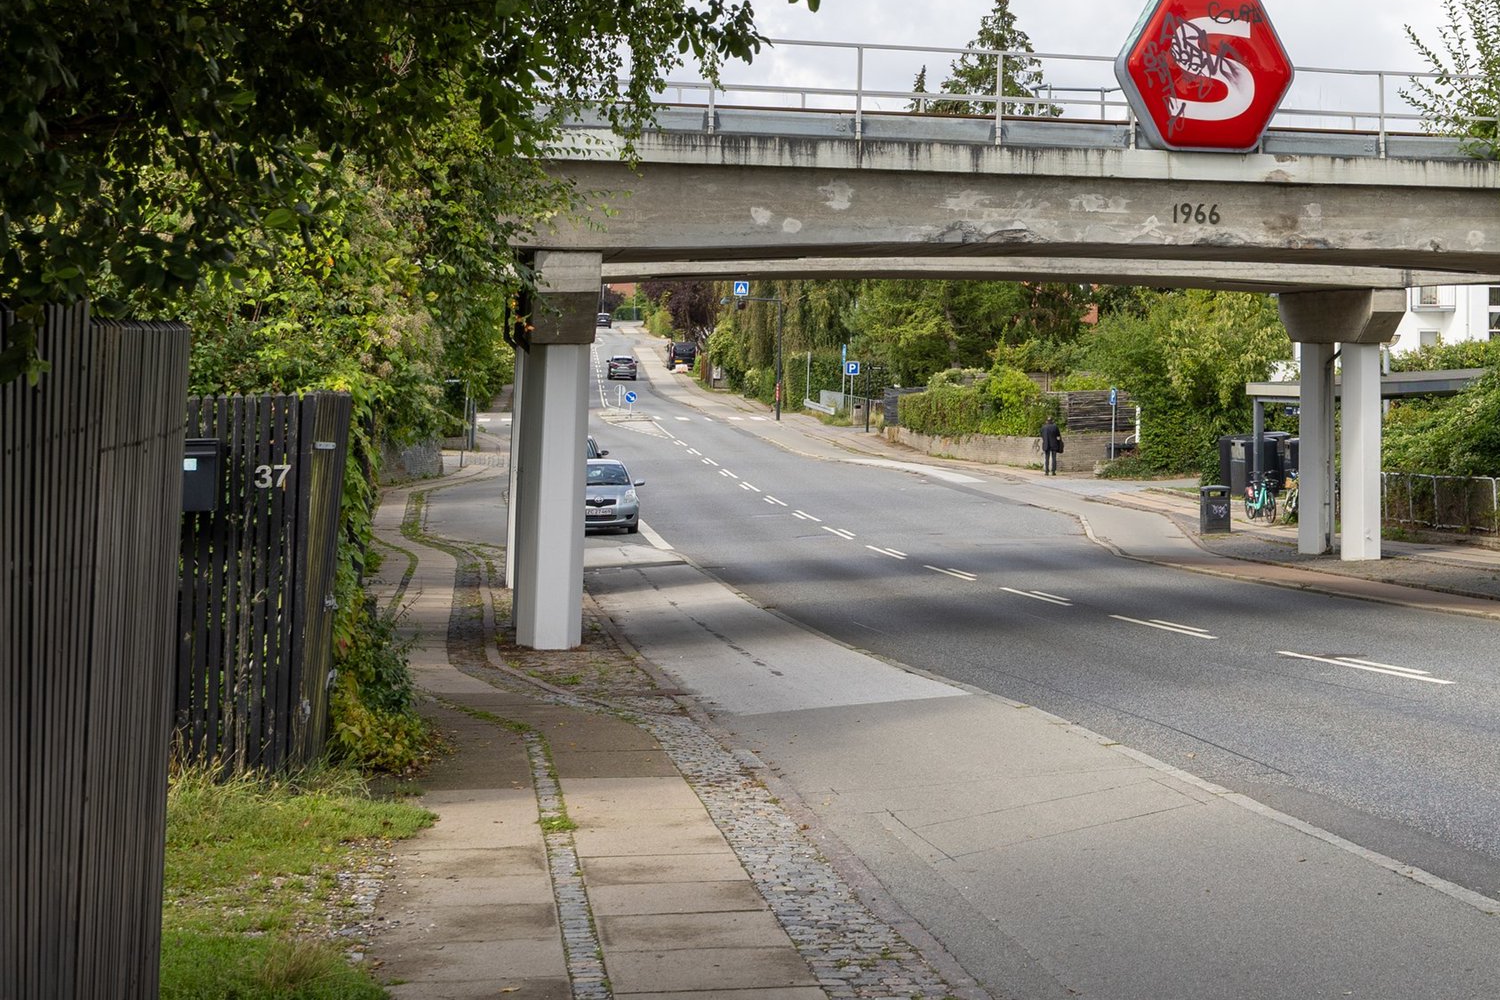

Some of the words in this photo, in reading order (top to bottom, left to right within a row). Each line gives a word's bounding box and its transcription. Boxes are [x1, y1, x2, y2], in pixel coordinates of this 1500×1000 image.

[1169, 16, 1256, 121] S
[1173, 203, 1221, 225] 1966
[848, 363, 857, 373] P
[254, 464, 292, 489] 37
